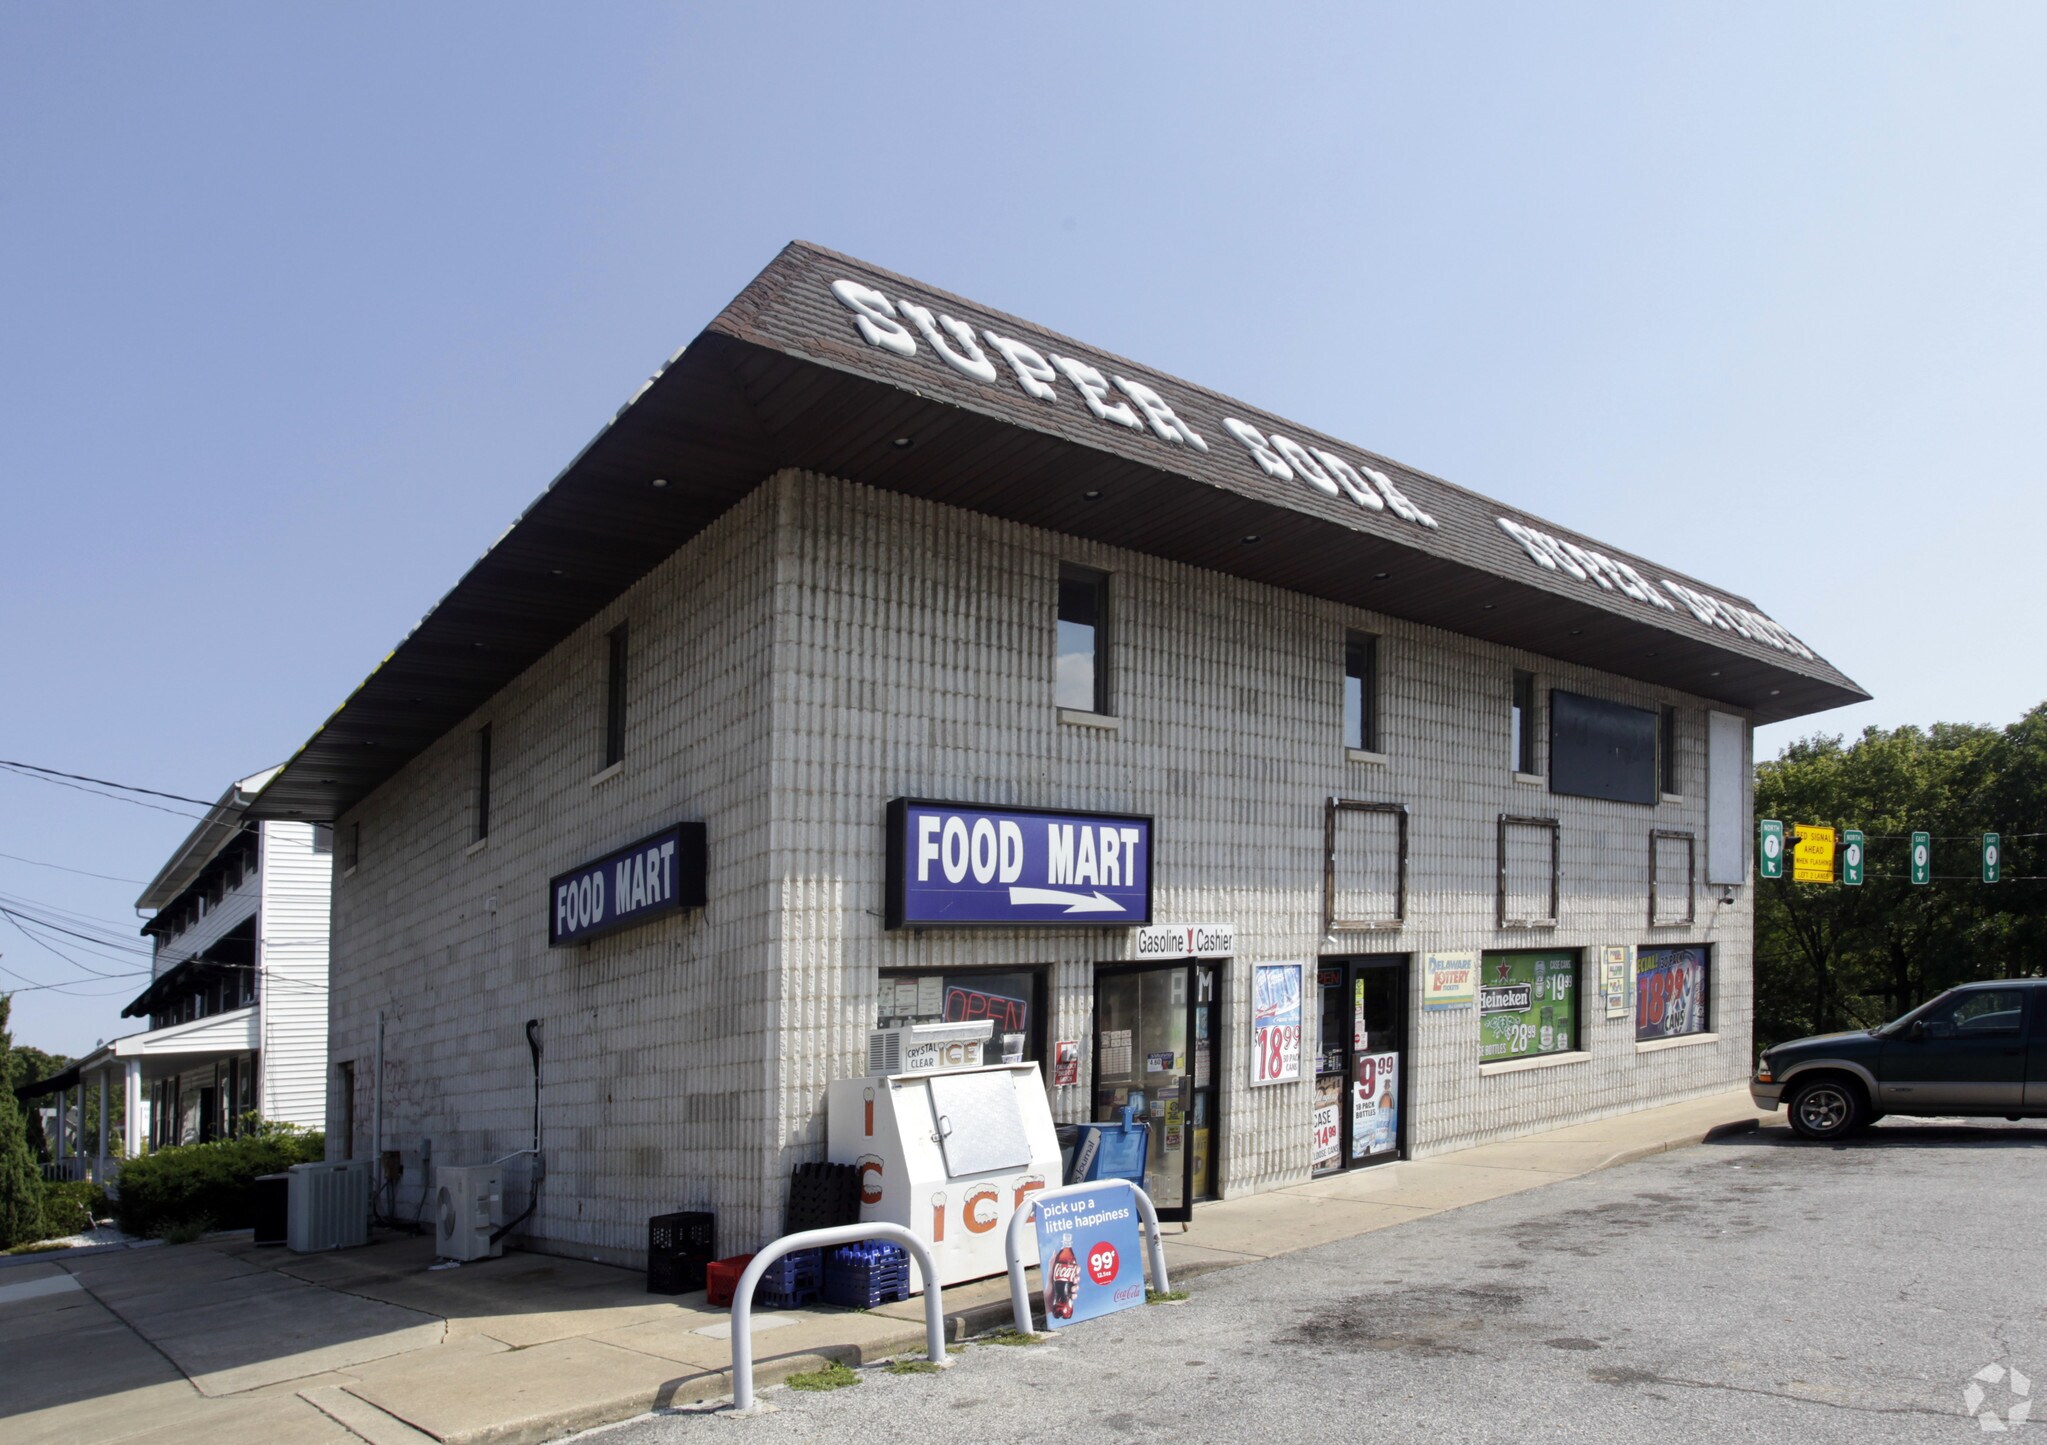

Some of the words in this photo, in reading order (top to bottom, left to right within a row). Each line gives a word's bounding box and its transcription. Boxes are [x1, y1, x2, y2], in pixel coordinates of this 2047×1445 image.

[831, 279, 1209, 453] SUPER
[1222, 417, 1438, 529] SODA
[1497, 518, 1675, 612] SUPER
[1660, 579, 1814, 661] SPIRITS
[1763, 824, 1780, 832] NORTH
[1811, 832, 1832, 843] SIGNAL
[918, 815, 1024, 884] FOOD
[1048, 823, 1139, 887] MART
[1769, 840, 1774, 853] 7
[1804, 845, 1824, 855] AHEAD
[1851, 849, 1856, 861] 7
[1918, 850, 1923, 861] 4
[1989, 851, 1993, 861] 4
[557, 870, 605, 936] FOOD
[615, 840, 675, 916] MART
[1138, 929, 1184, 953] Gasoline
[1196, 928, 1233, 952] Cashier
[1428, 956, 1472, 975] DELAWARE
[1317, 971, 1340, 985] PEN
[1433, 970, 1470, 991] LOTTERY
[1480, 990, 1528, 1009] Heineken
[946, 990, 1025, 1030] OPEN
[1664, 1009, 1684, 1032] CANS
[907, 1042, 938, 1059] CRYSTAL
[938, 1040, 979, 1066] ICE
[1289, 1053, 1299, 1062] PAC
[911, 1057, 934, 1069] CLEAR
[1356, 1110, 1376, 1119] BOTTLES
[1362, 1101, 1375, 1110] PACK
[1076, 1139, 1095, 1177] Journal
[931, 1174, 1045, 1242] ICE
[1043, 1202, 1069, 1220] pick
[1071, 1200, 1086, 1214] up
[1088, 1199, 1096, 1209] a
[1045, 1218, 1073, 1235] little
[1075, 1208, 1130, 1229] happiness
[1113, 1285, 1140, 1302] Coca-Cola
